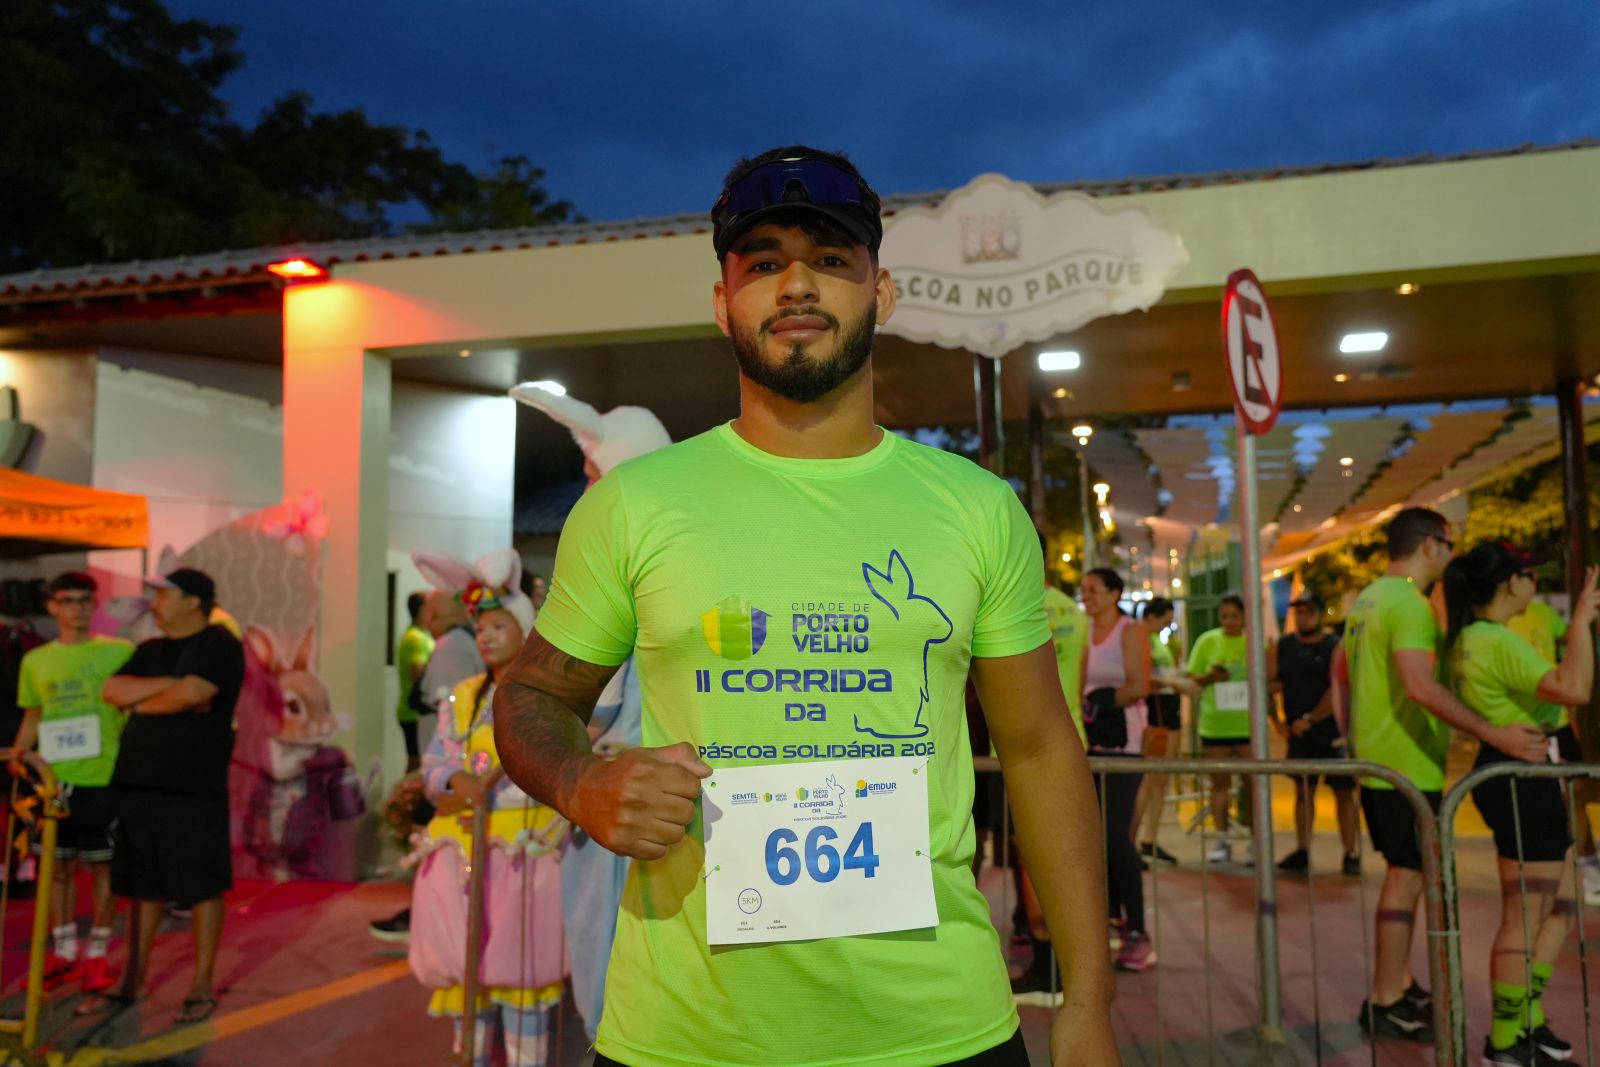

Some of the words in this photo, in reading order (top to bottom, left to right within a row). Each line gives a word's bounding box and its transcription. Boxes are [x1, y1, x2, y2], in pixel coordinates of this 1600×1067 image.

[894, 275, 961, 305] SCOA
[975, 283, 1013, 308] NO
[1025, 257, 1144, 302] PARQUE
[791, 602, 845, 612] CIDADE
[853, 603, 871, 613] DE
[792, 613, 870, 633] PORTO
[791, 633, 869, 653] VELHO
[695, 669, 711, 693] II
[721, 668, 893, 693] CORRIDA
[901, 741, 936, 758] 202
[867, 782, 897, 791] EMDUR
[731, 792, 758, 801] SEMTEL
[764, 821, 880, 886] 664
[741, 897, 759, 905] 5KM
